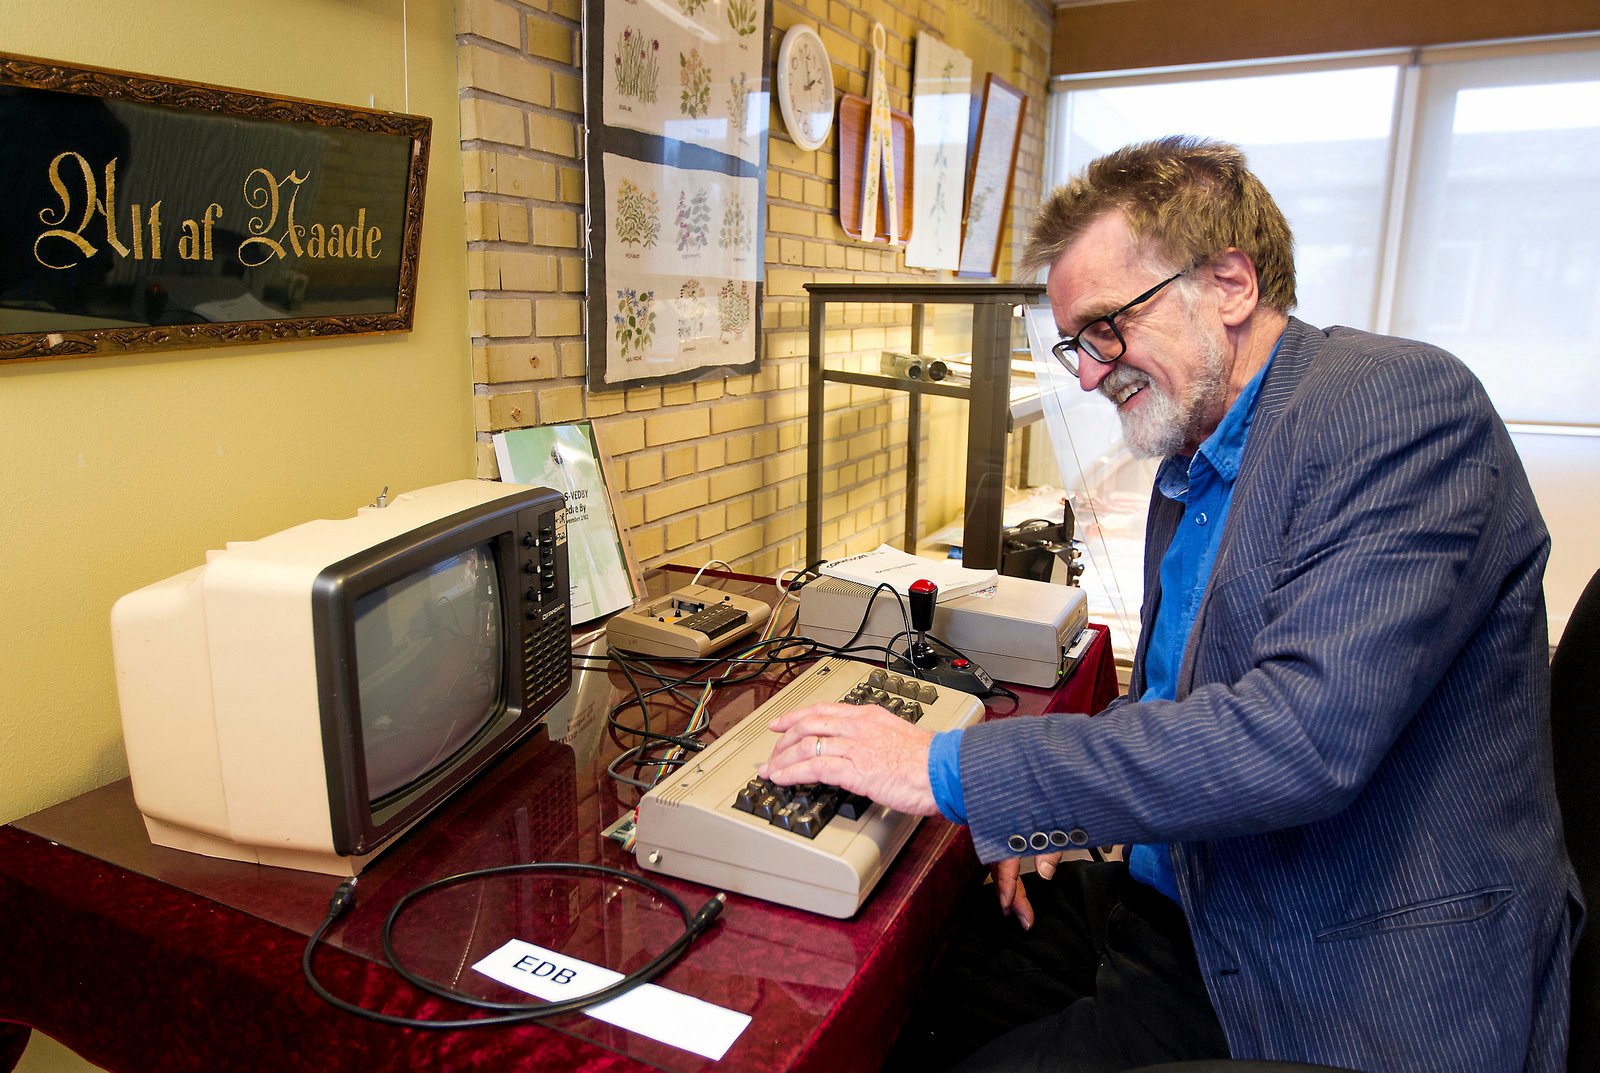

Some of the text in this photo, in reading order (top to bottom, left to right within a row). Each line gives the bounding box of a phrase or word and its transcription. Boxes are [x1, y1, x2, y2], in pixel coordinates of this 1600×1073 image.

[34, 152, 382, 270] Alt af Naade
[512, 954, 578, 985] EDB
